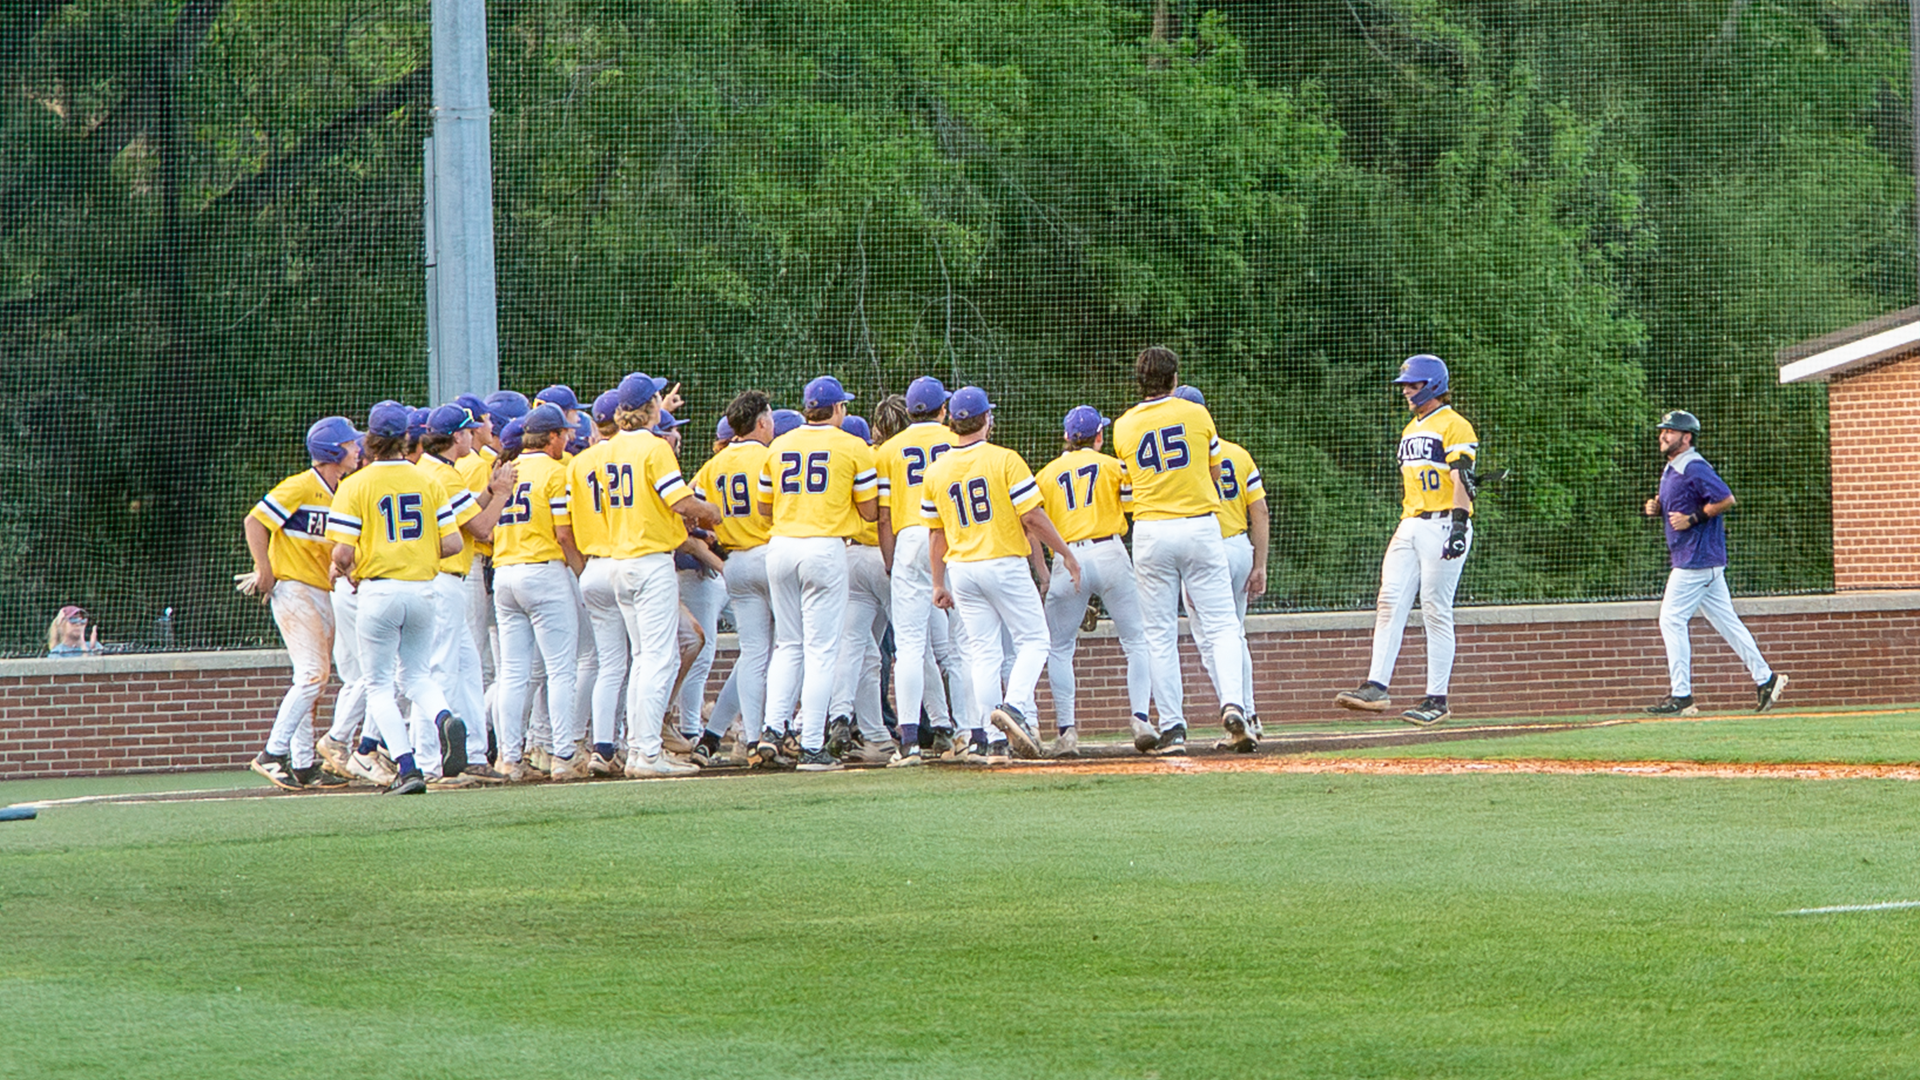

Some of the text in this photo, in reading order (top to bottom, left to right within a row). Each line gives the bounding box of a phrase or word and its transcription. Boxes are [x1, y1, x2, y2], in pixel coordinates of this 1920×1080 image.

[1136, 423, 1191, 474] 45
[605, 462, 634, 508] 20
[716, 472, 751, 517] 19
[780, 450, 831, 495] 26
[1056, 463, 1101, 511] 17
[1215, 458, 1240, 501] 3
[1419, 469, 1440, 492] 10
[378, 492, 423, 543] 15
[948, 476, 993, 528] 18
